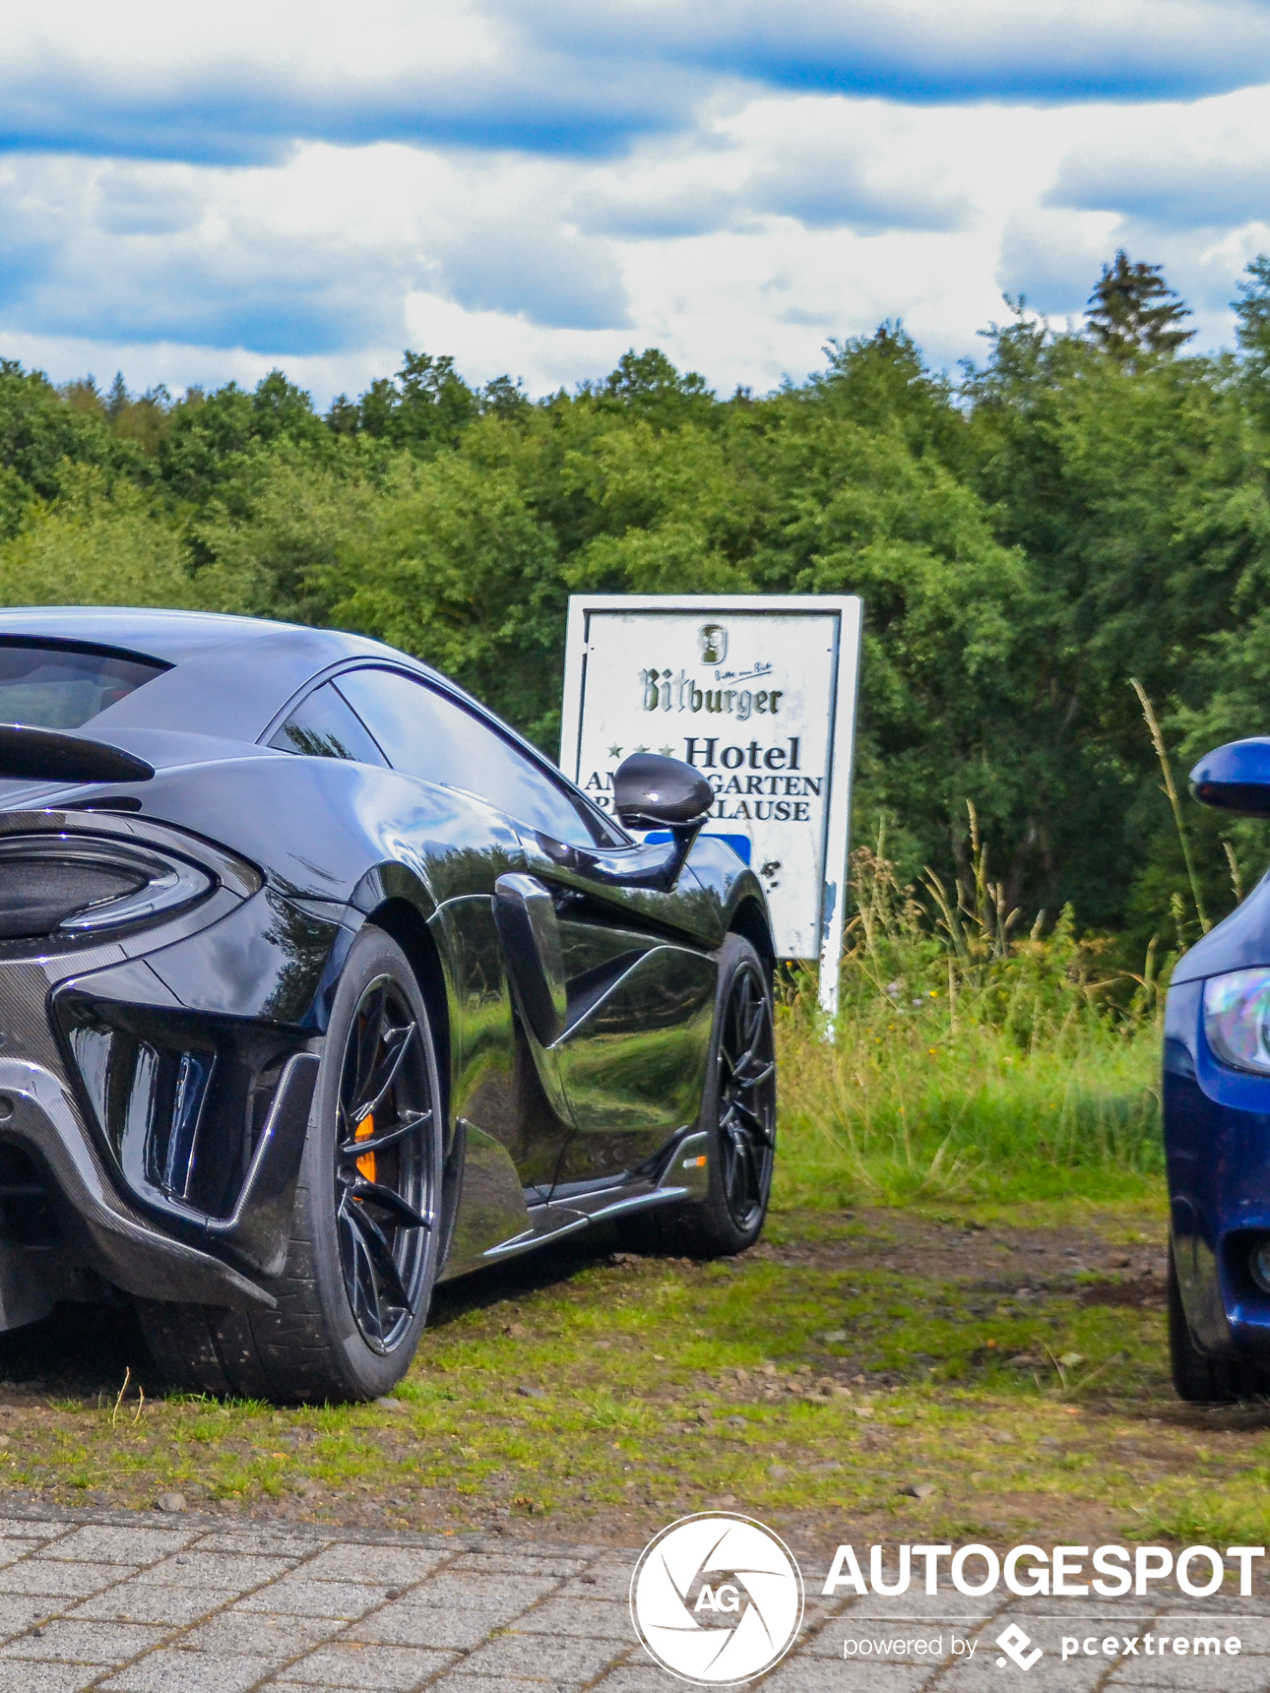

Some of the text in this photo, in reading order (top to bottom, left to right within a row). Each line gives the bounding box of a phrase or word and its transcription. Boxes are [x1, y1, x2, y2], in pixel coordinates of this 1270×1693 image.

[638, 668, 783, 721] Bitburger
[683, 736, 801, 770] Hotel
[706, 773, 824, 797] GARTEN
